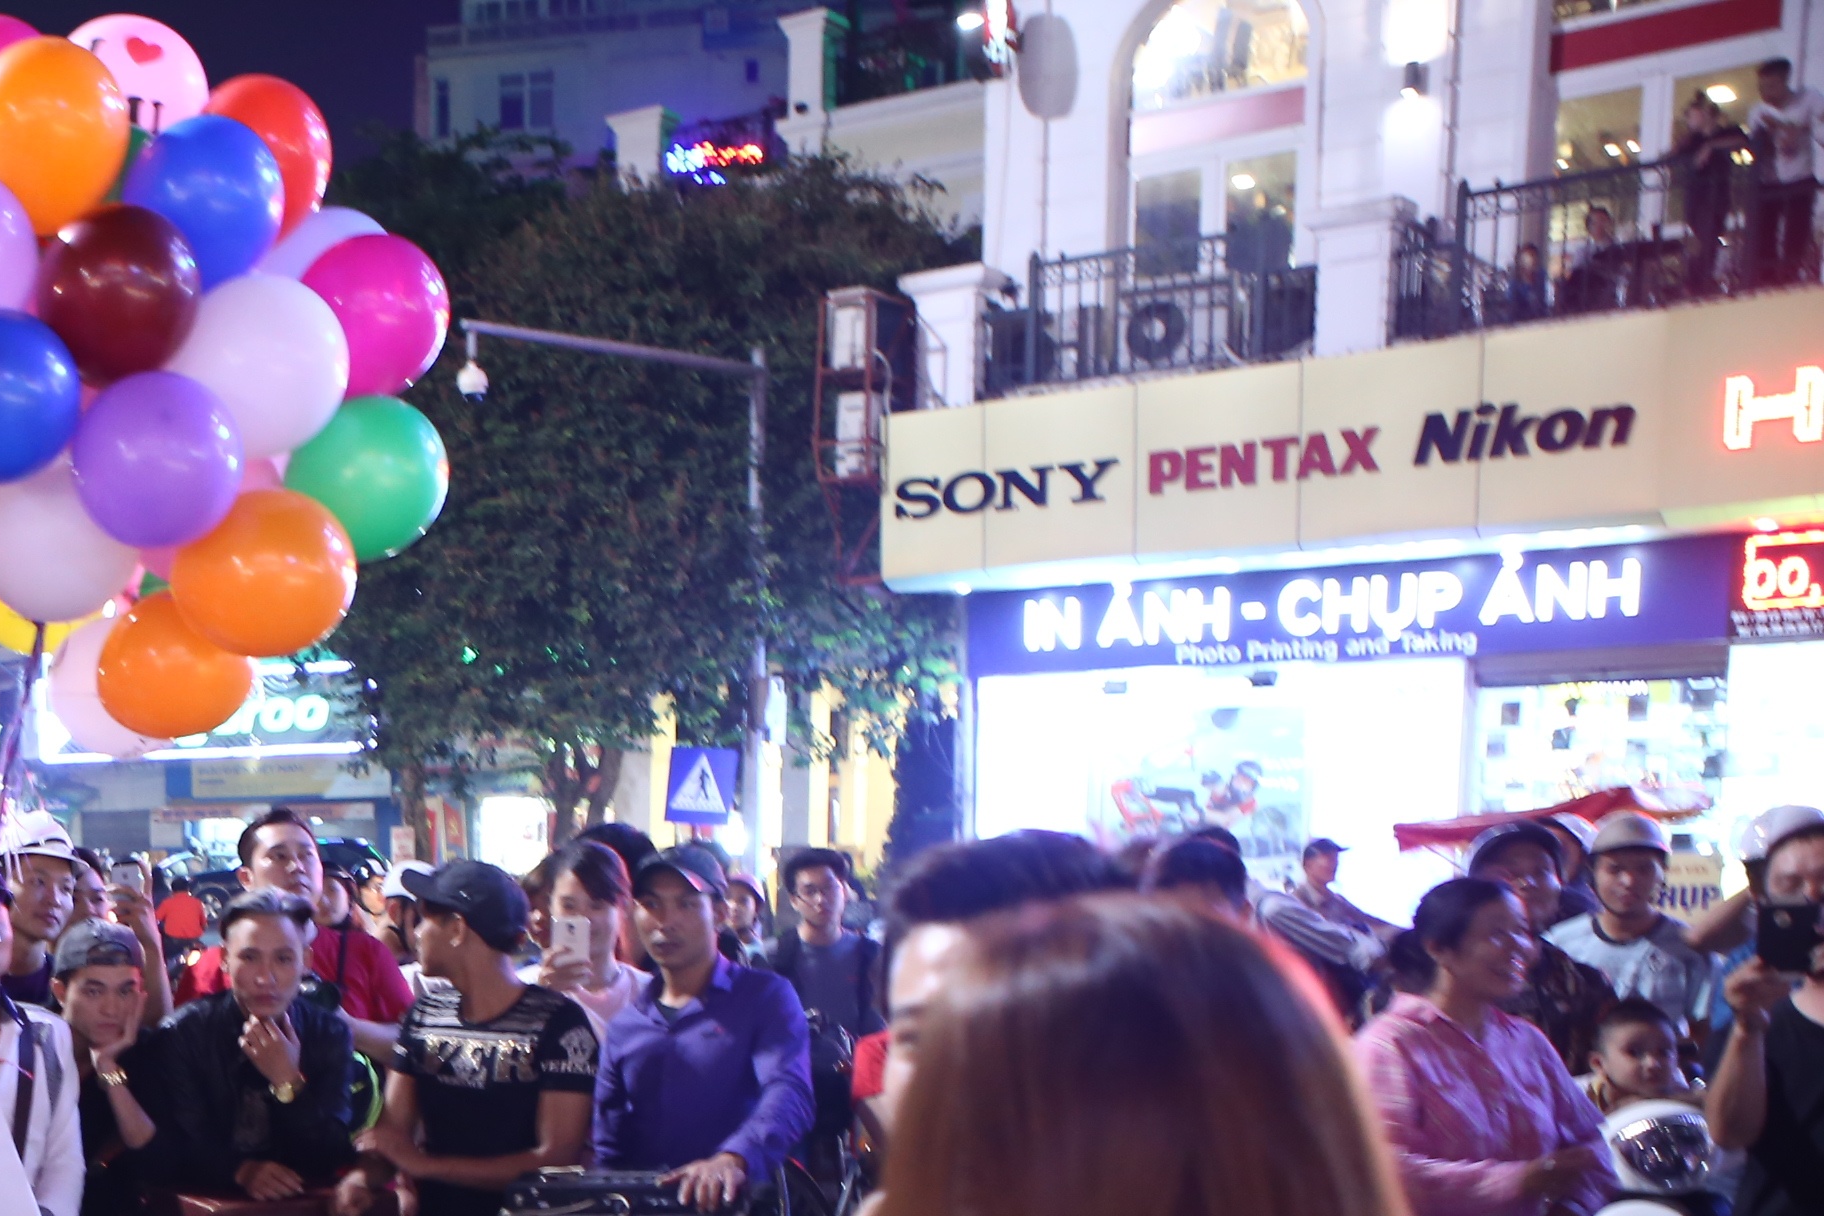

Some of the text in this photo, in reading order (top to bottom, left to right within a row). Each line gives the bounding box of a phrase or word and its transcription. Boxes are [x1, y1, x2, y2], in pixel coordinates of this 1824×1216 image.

[894, 402, 1637, 520] SONY PENTAX Nikon
[1023, 596, 1082, 653] IN
[1095, 580, 1232, 650] ẢNH
[1277, 571, 1464, 643] CHỤP
[1478, 546, 1642, 627] ẢNH
[1176, 631, 1477, 665] Photo Printing and Taking
